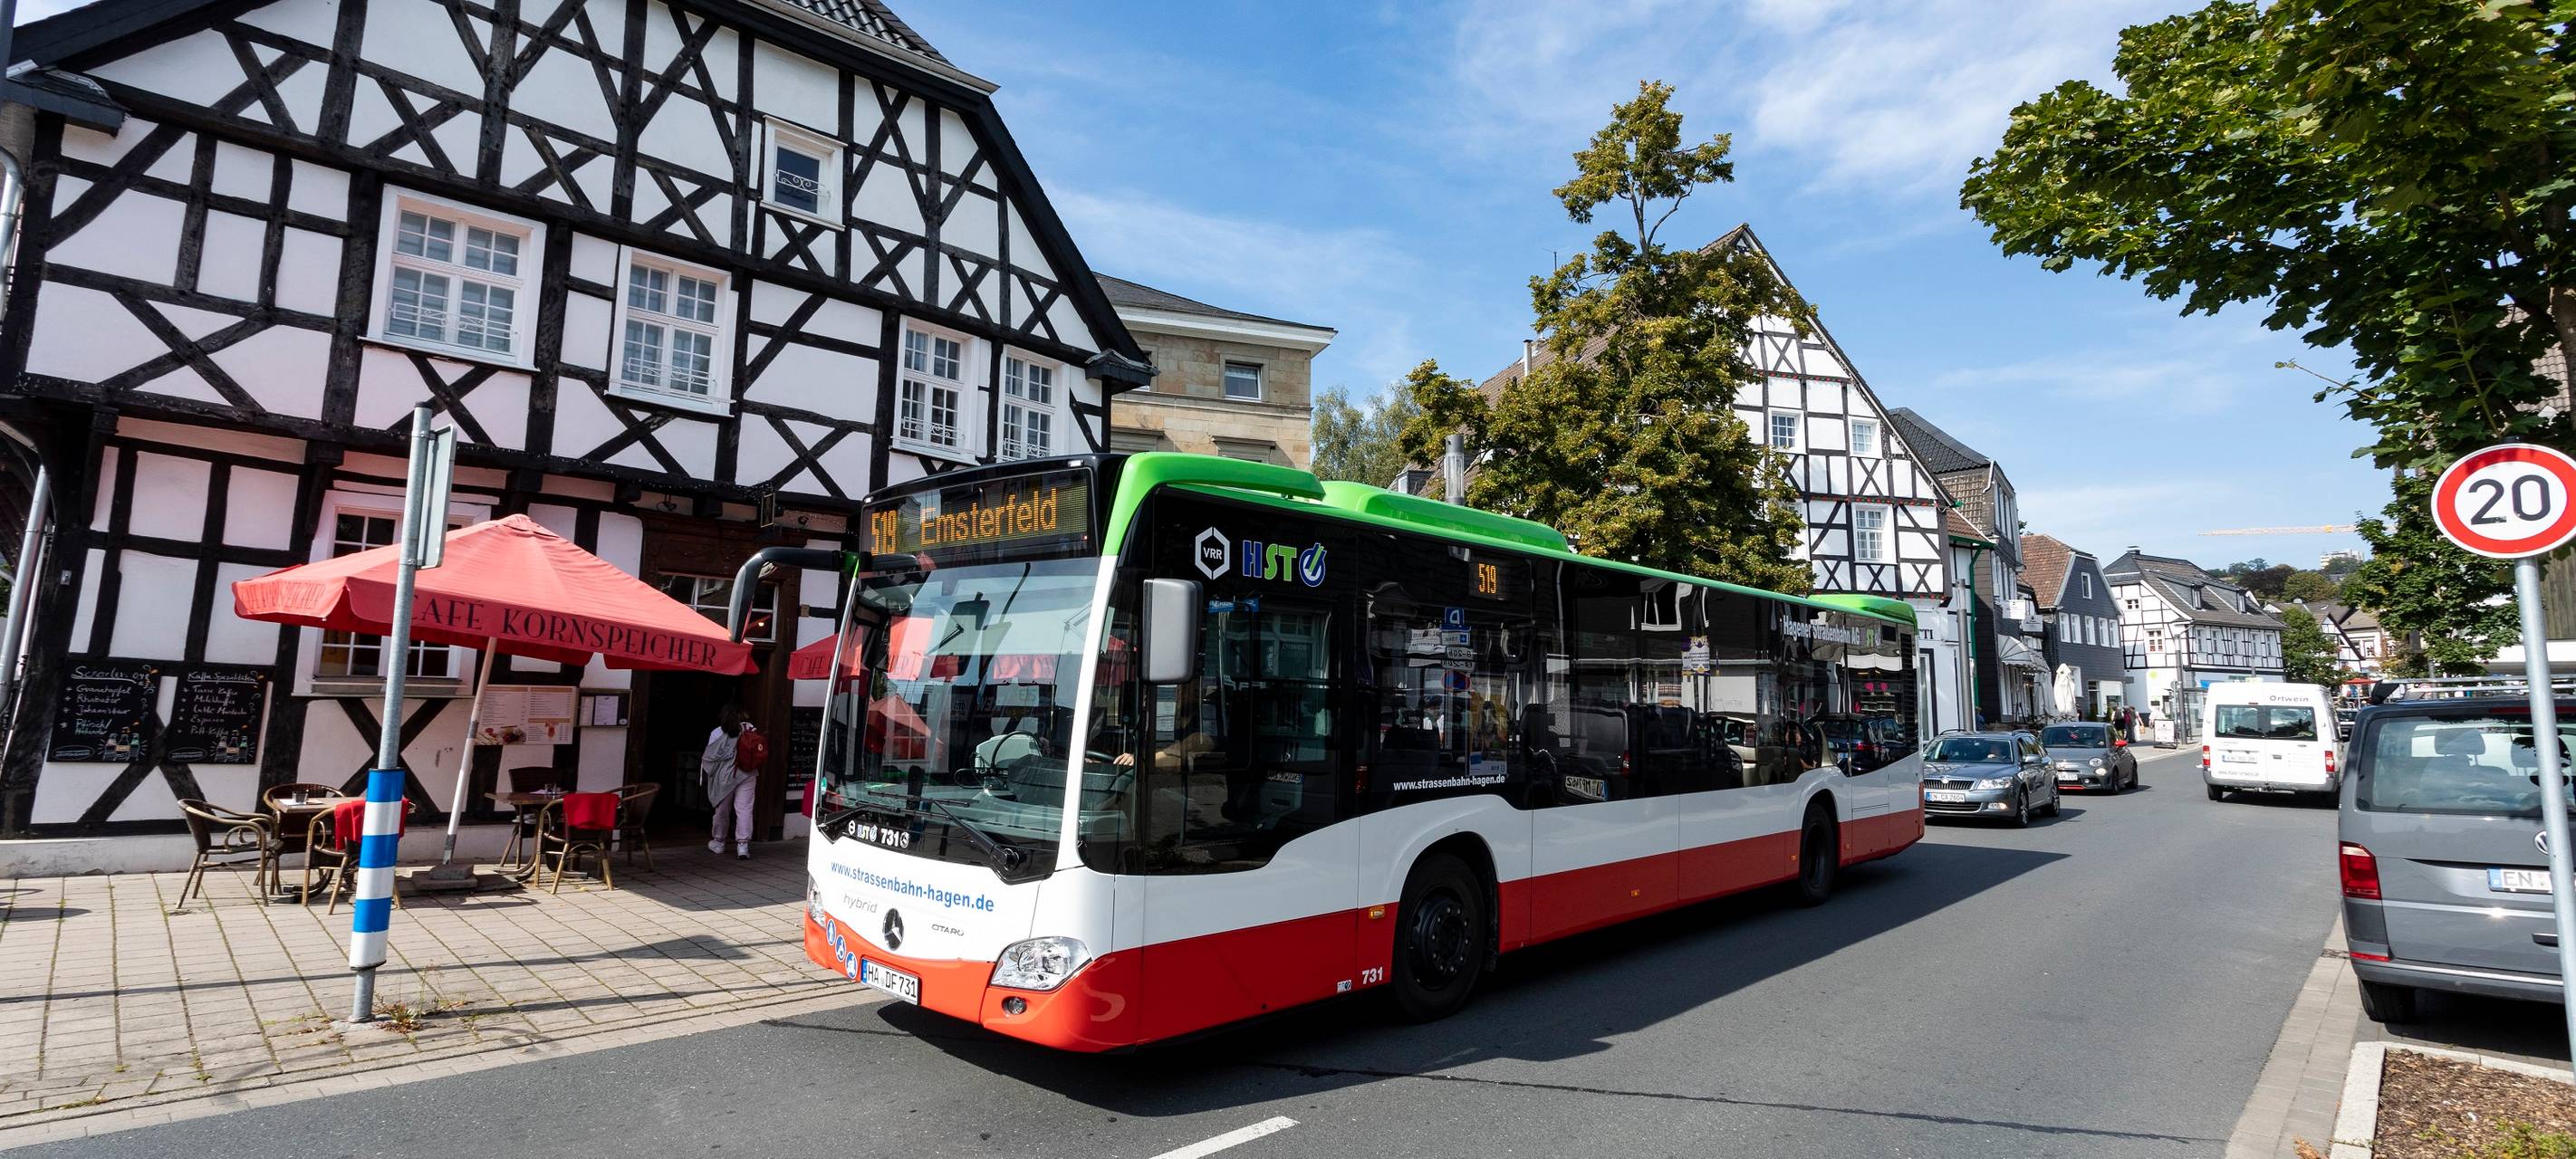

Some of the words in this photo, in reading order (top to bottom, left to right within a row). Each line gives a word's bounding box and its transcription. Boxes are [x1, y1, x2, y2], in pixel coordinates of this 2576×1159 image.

[2468, 474, 2551, 525] 20
[870, 509, 897, 556] 519
[920, 488, 1057, 545] Emsterfeld
[1203, 547, 1223, 560] VRR
[1243, 540, 1297, 581] HST
[1478, 563, 1497, 595] 519
[503, 608, 716, 667] KORNSPEICHER
[1783, 615, 1811, 642] Hagener
[1851, 627, 1860, 646] AG
[2269, 694, 2309, 703] Ortwein
[1393, 773, 1505, 791] www.strassenbahn-hagen.de
[880, 828, 899, 848] 731
[831, 861, 995, 913] www.strassenbahn-hagen.de
[2504, 871, 2533, 887] EN
[843, 894, 879, 914] hybrid
[931, 924, 965, 937] CITARO
[868, 964, 879, 984] HA
[885, 971, 898, 991] DF
[899, 976, 917, 999] 731
[1361, 966, 1383, 985] 731
